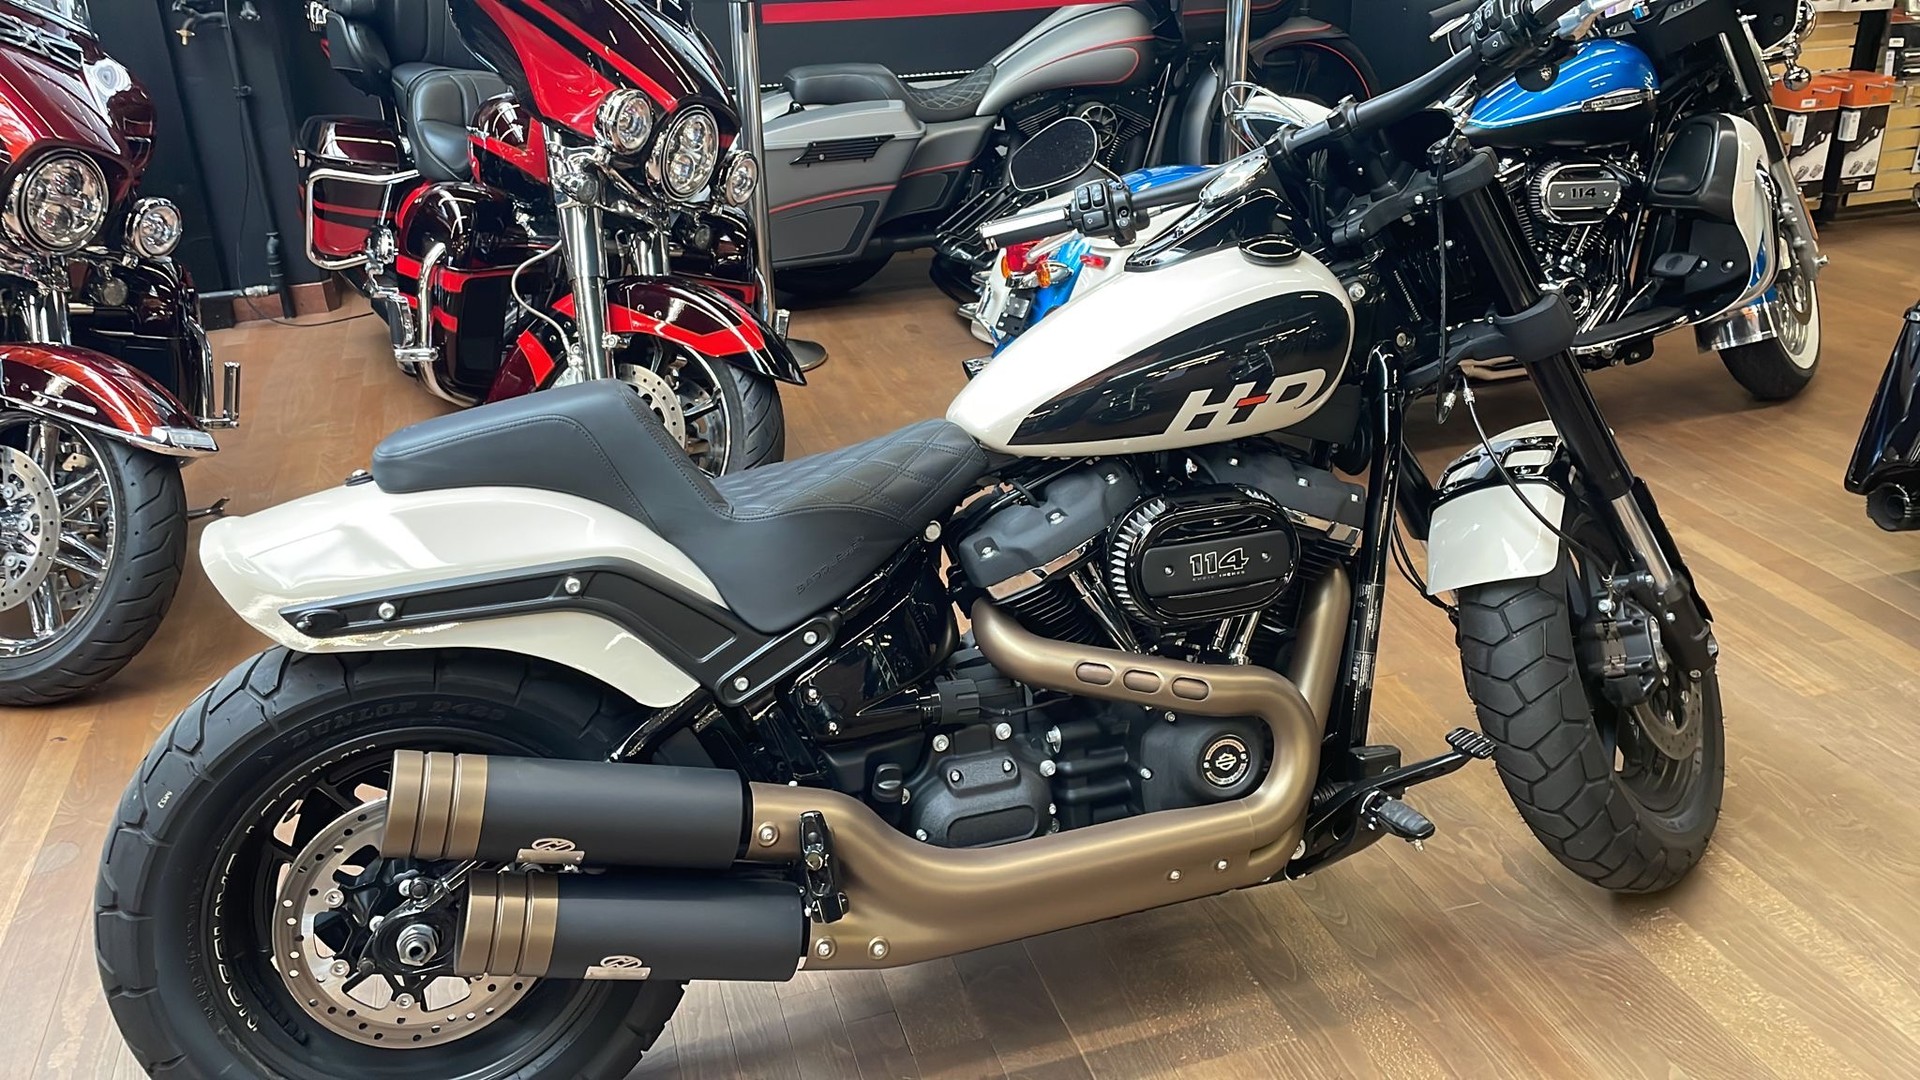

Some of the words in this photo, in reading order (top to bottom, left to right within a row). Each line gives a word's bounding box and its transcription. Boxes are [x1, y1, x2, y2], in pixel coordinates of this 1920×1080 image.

[1571, 187, 1597, 199] 114
[1163, 368, 1327, 434] H-D
[1189, 547, 1249, 577] 114
